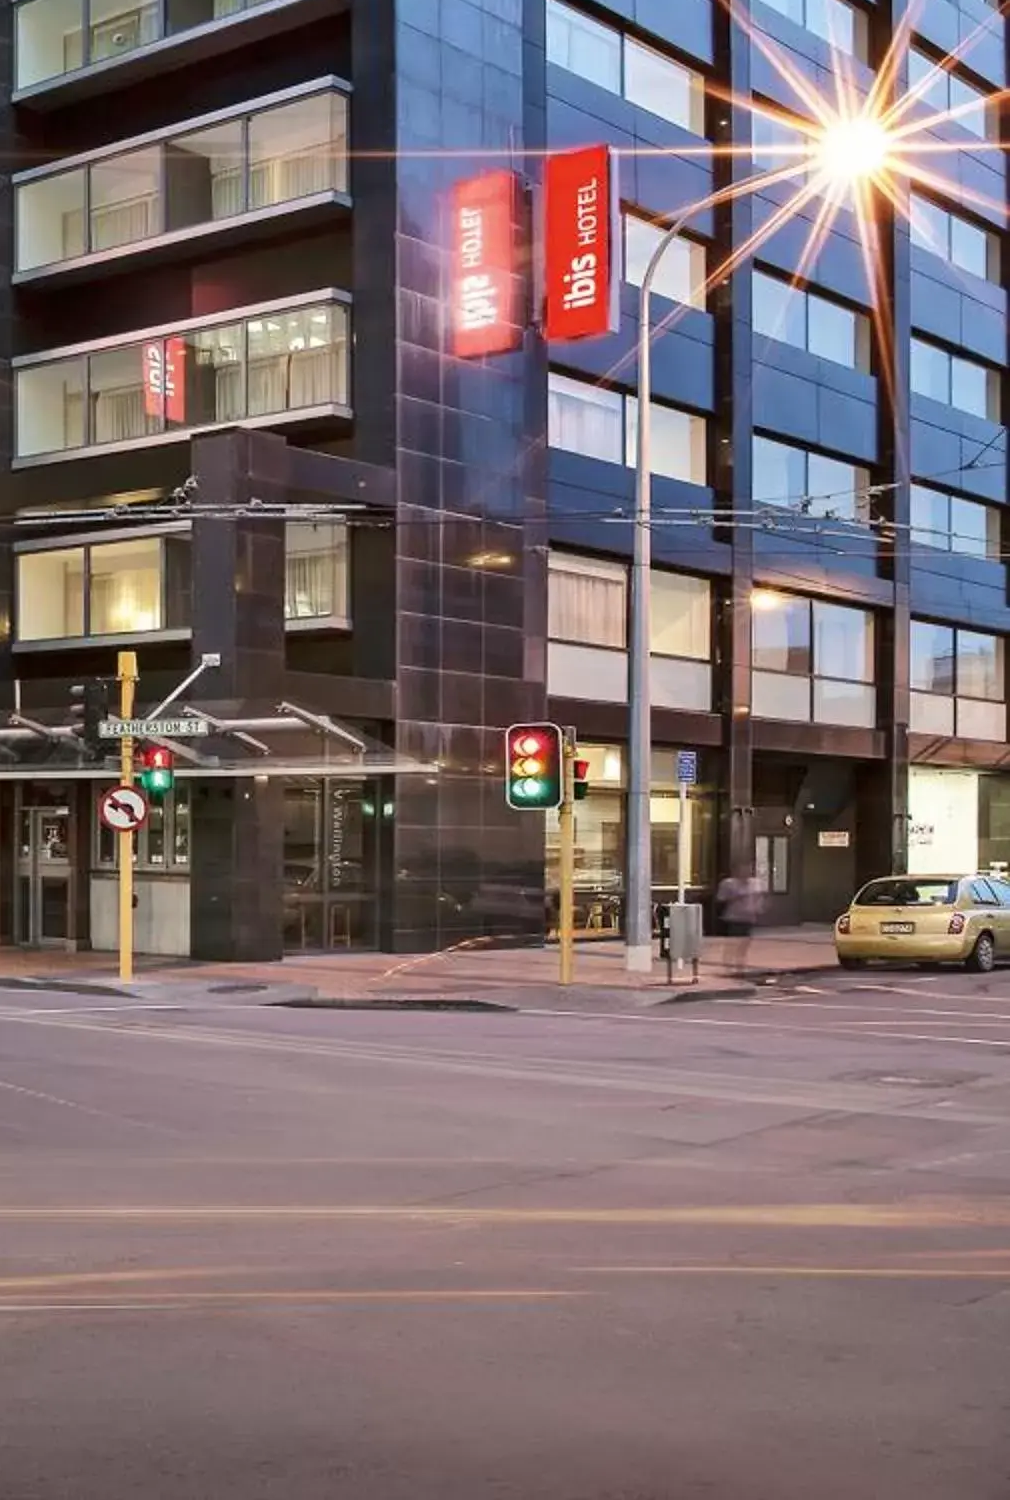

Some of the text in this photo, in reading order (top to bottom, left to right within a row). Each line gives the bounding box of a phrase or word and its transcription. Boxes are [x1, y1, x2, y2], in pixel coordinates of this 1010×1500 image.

[563, 176, 598, 310] ibis HOTEL
[107, 721, 199, 735] FEATHERSTON ST
